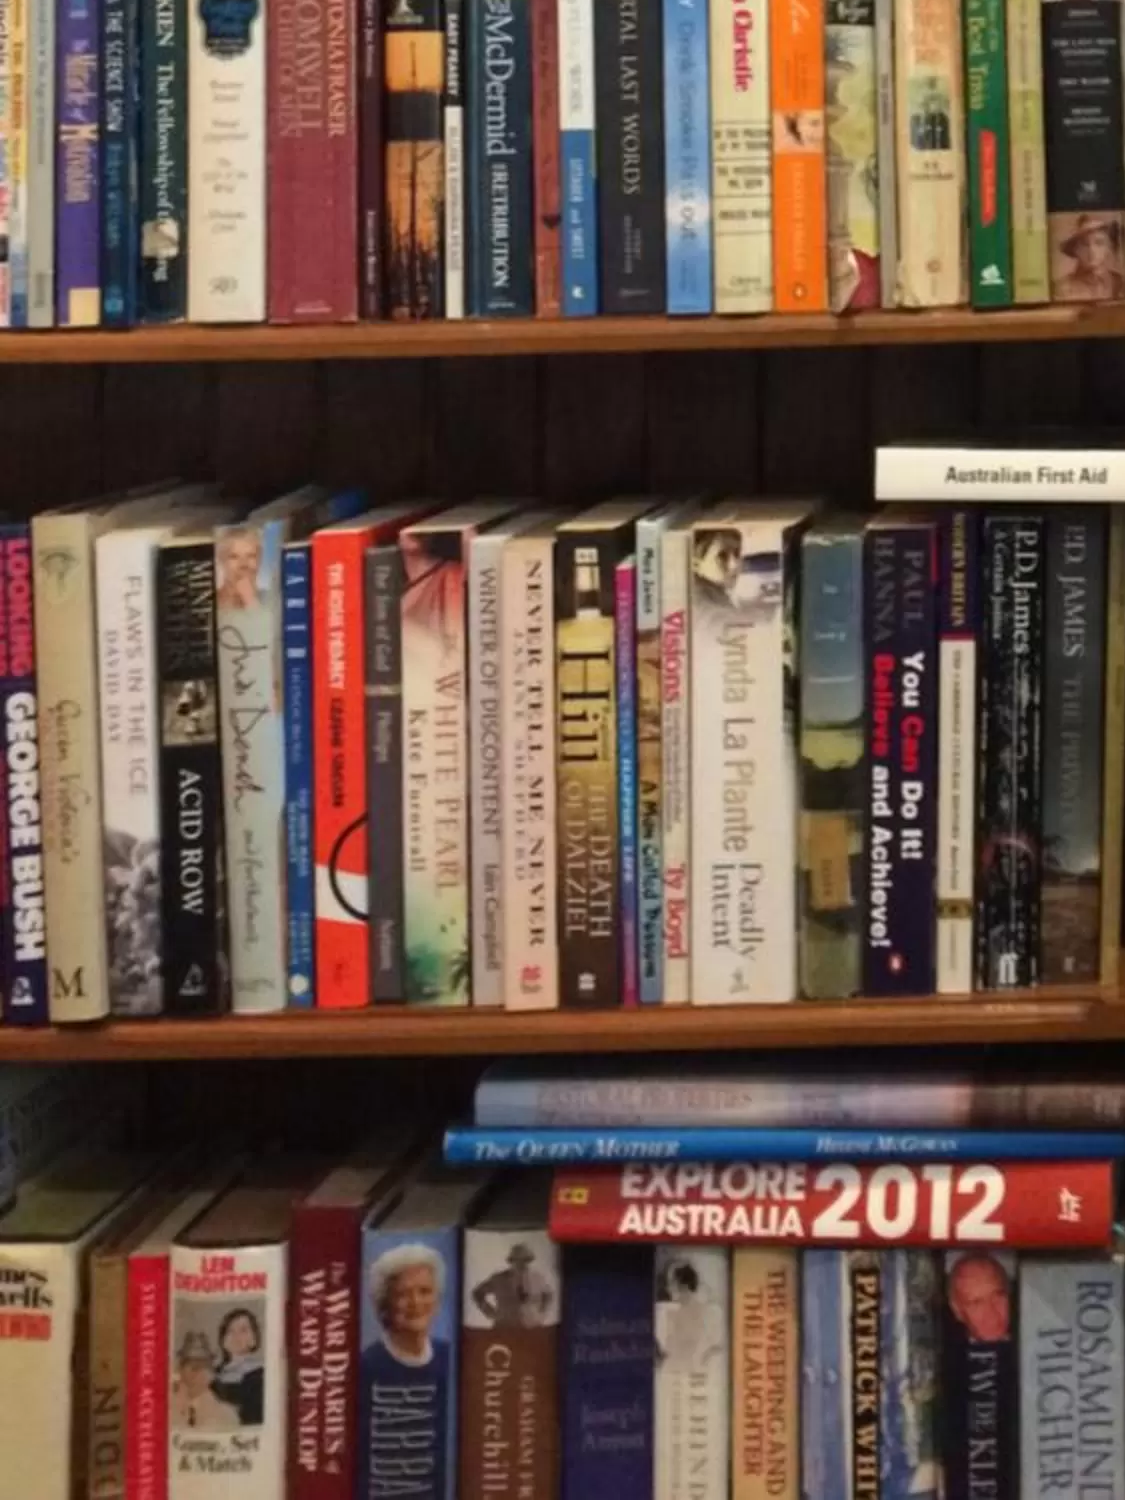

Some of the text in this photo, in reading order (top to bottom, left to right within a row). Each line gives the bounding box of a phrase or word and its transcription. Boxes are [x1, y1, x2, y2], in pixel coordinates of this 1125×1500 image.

[107, 10, 124, 132] THE SCIENCE SHOW
[153, 61, 175, 95] The
[446, 13, 459, 42] EASY
[619, 54, 640, 104] LAST
[732, 8, 756, 94] Christie
[152, 96, 176, 185] Fellowship
[328, 63, 347, 137] FRASER
[484, 13, 518, 289] McDermid RETRIBUTION
[620, 112, 642, 196] WORDS
[944, 466, 1108, 485] Australian First Aid
[478, 566, 497, 657] WINTER
[1008, 529, 1039, 655] P.D. James
[1059, 575, 1088, 657] JAMES
[103, 629, 122, 744] DAVID DAY
[123, 574, 151, 795] FLAWS IN THE ICE
[480, 660, 498, 689] OF
[560, 645, 612, 766] Hill
[660, 610, 687, 704] Visions
[407, 708, 427, 765] Kate
[432, 670, 463, 897] WHITE PEARL
[480, 697, 501, 841] DISCONTENT
[525, 559, 547, 949] NEVER TELL ME NEVER
[715, 621, 757, 853] Lynda La Plante
[899, 651, 925, 860] You Can Do It!
[6, 691, 48, 962] GEORGE BUSH
[178, 768, 204, 916] ACID ROW
[868, 653, 896, 949] Believe and Achieve!
[565, 819, 589, 937] DALZIEL
[588, 833, 613, 938] DEATH
[663, 861, 689, 889] Ty
[709, 862, 736, 949] Intent
[735, 861, 765, 963] Deadly
[664, 896, 691, 961] Boyd
[474, 1140, 510, 1161] The
[620, 1163, 806, 1201] EXPLORE
[811, 1163, 1007, 1241] 2012
[200, 1256, 236, 1274] LEN
[618, 1204, 804, 1237] AUSTRALIA
[298, 1268, 326, 1472] WEARY DUNLOP
[323, 1288, 351, 1455] WAR DIARIES
[743, 1290, 764, 1476] THE LAUGHTER
[766, 1268, 789, 1496] THE WEEPING AND
[854, 1274, 879, 1414] PATRICK
[1037, 1326, 1074, 1495] PILCHER
